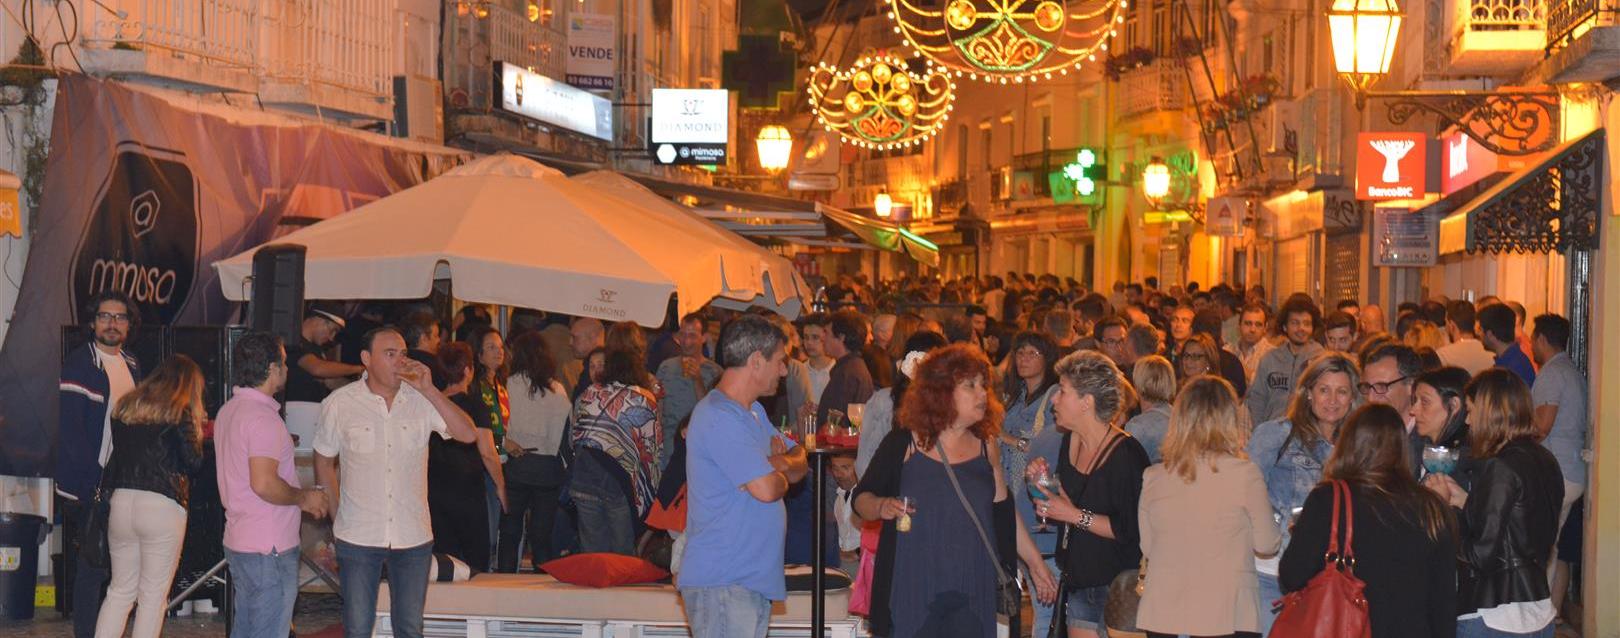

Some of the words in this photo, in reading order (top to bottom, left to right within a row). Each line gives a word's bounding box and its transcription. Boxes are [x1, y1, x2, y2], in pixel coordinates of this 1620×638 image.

[569, 45, 614, 60] VENDE
[659, 121, 723, 134] DIAMOND
[690, 147, 725, 157] mimosa
[88, 249, 177, 305] mimosa
[582, 303, 626, 317] DIAMOND
